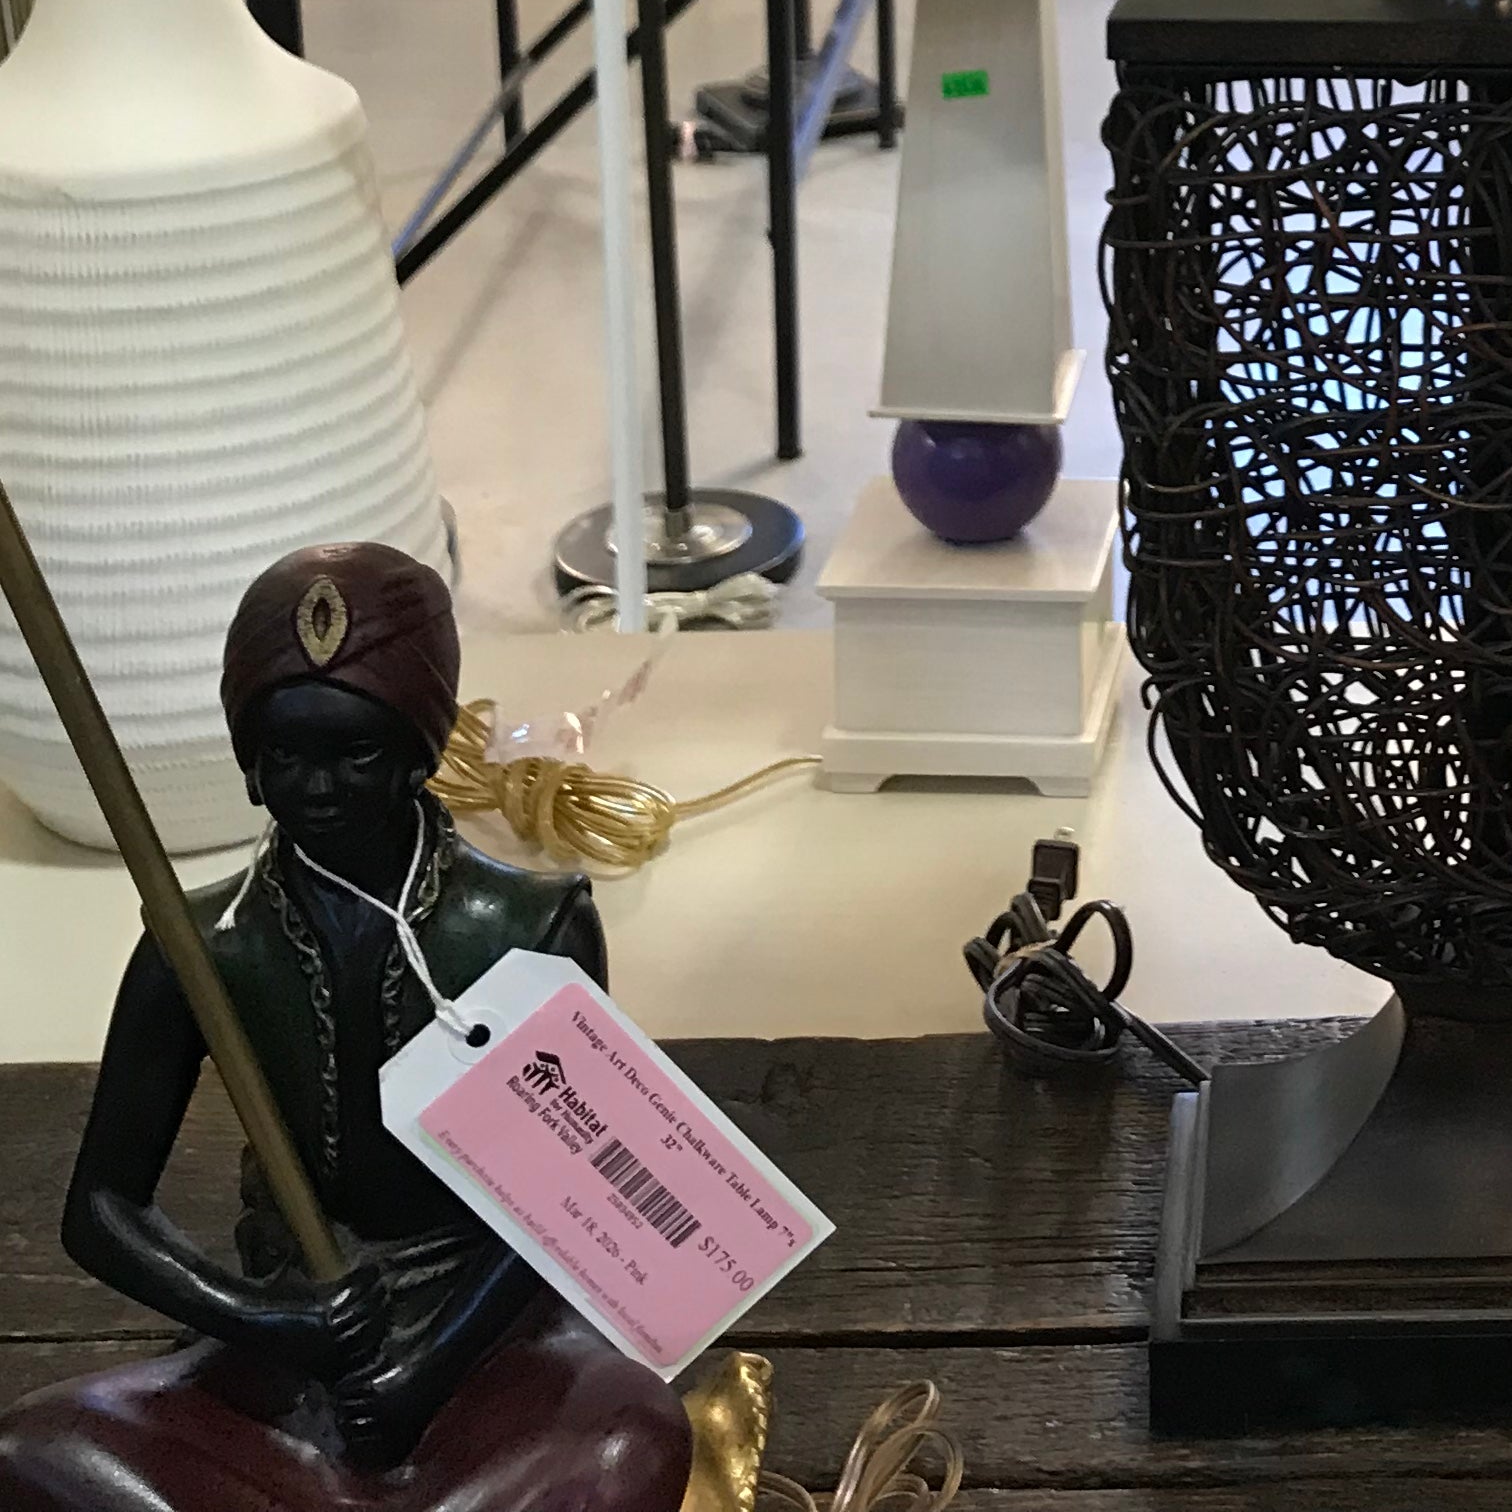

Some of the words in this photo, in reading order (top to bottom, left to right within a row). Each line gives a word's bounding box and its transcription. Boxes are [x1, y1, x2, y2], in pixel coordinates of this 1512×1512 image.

[505, 1074, 541, 1113] Roaring
[537, 1106, 560, 1131] Fork
[555, 1125, 583, 1155] Valley
[549, 1098, 563, 1111] for
[559, 1109, 594, 1145] Humanity
[557, 1085, 608, 1137] Habitat
[569, 1010, 609, 1052] Vintage
[607, 1050, 627, 1071] Art
[623, 1066, 650, 1096] Deco
[647, 1092, 677, 1124] Genie
[674, 1121, 727, 1175] Chalkware
[724, 1171, 752, 1201] Table
[748, 1197, 779, 1230] Lamp
[660, 1133, 683, 1153] 32"
[560, 1195, 584, 1219] Mar
[623, 1258, 649, 1285] Pink
